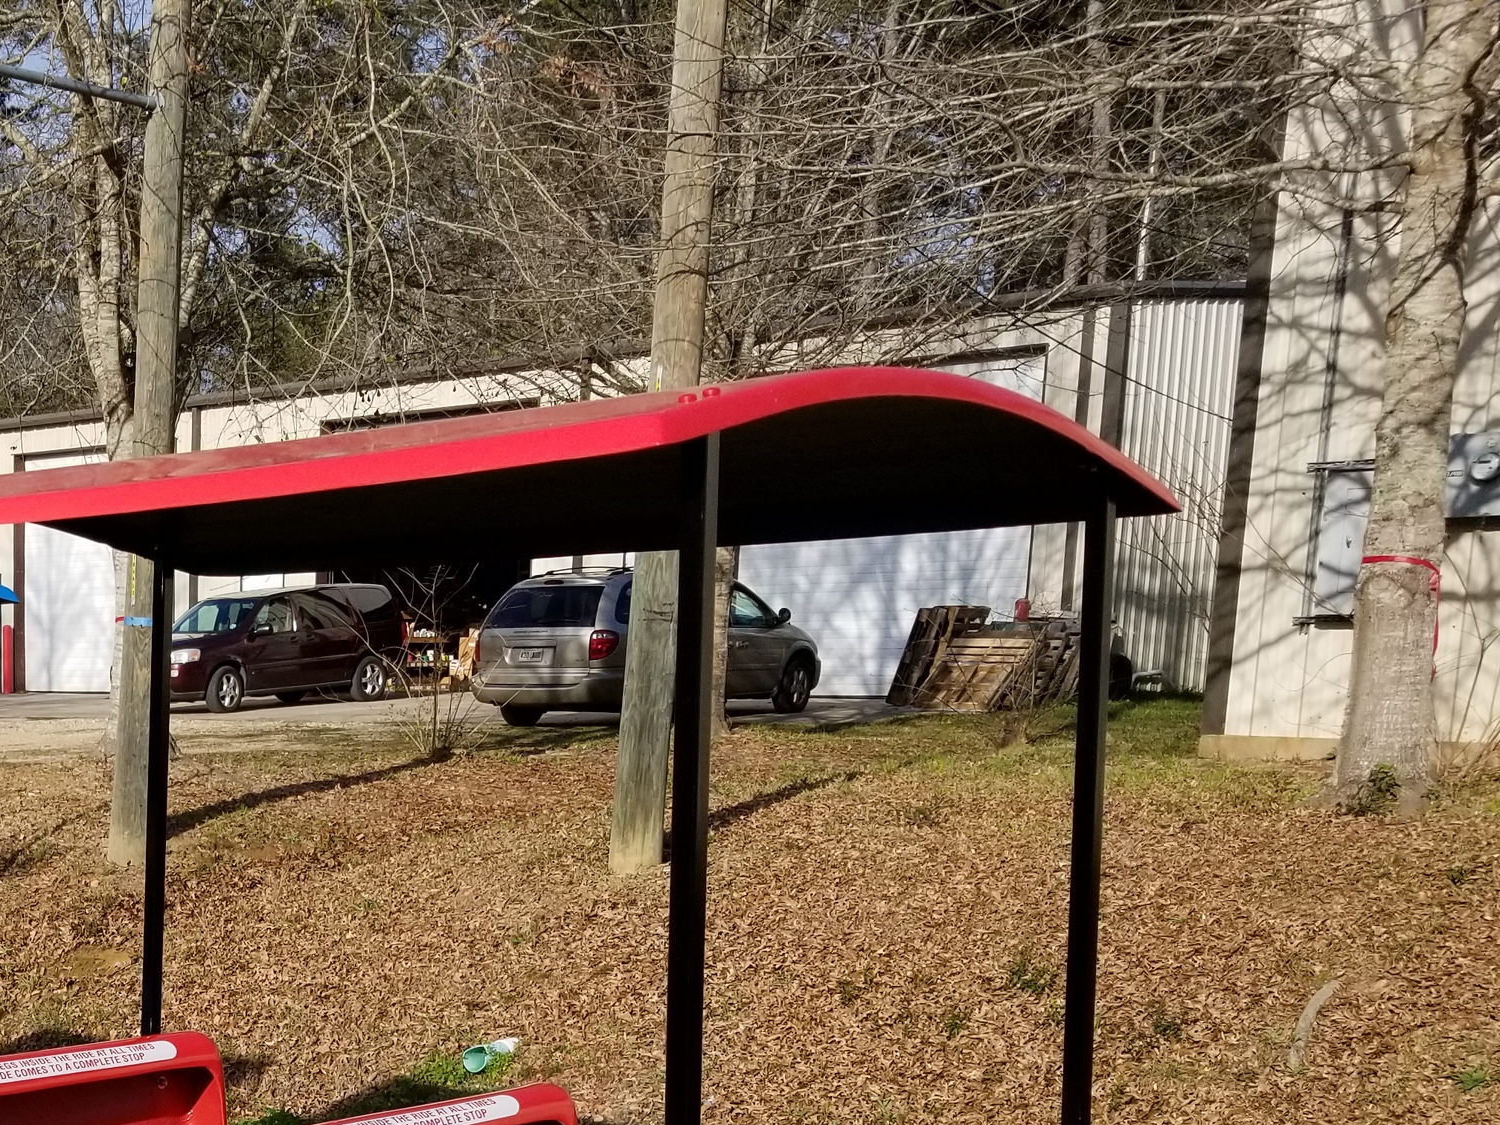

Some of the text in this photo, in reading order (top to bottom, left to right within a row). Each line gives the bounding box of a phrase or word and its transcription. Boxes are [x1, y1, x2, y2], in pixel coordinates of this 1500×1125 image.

[15, 1065, 48, 1077] COMES
[50, 1063, 63, 1072] TO
[65, 1062, 72, 1070] A
[72, 1056, 120, 1069] COMPLETE
[122, 1052, 145, 1062] STOP
[19, 1057, 52, 1067] INSIDE
[53, 1054, 70, 1062] THE
[72, 1051, 94, 1060] RIDE
[96, 1049, 108, 1057] AT
[110, 1047, 126, 1055] ALL
[127, 1043, 154, 1052] TIMES
[393, 1114, 410, 1123] THE
[412, 1110, 434, 1119] RIDE
[436, 1107, 448, 1115] AT
[450, 1103, 468, 1112] ALL
[468, 1098, 496, 1109] TIMES
[465, 1109, 487, 1121] STOP
